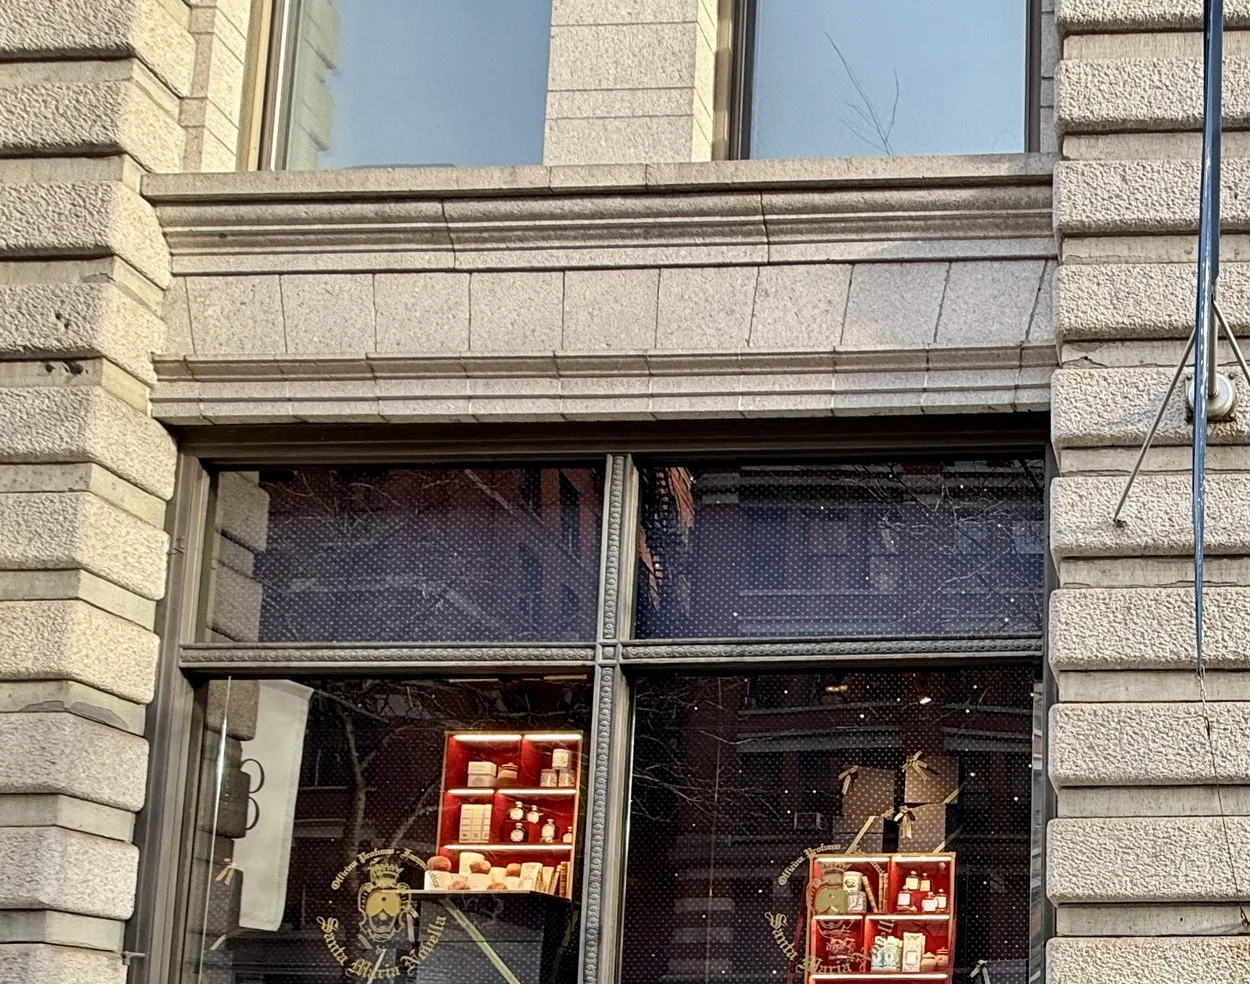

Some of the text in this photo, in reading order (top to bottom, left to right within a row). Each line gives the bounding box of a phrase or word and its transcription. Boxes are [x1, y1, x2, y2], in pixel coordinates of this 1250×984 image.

[316, 915, 348, 967] Santa
[400, 915, 446, 976] Novella
[764, 911, 798, 960] Santa
